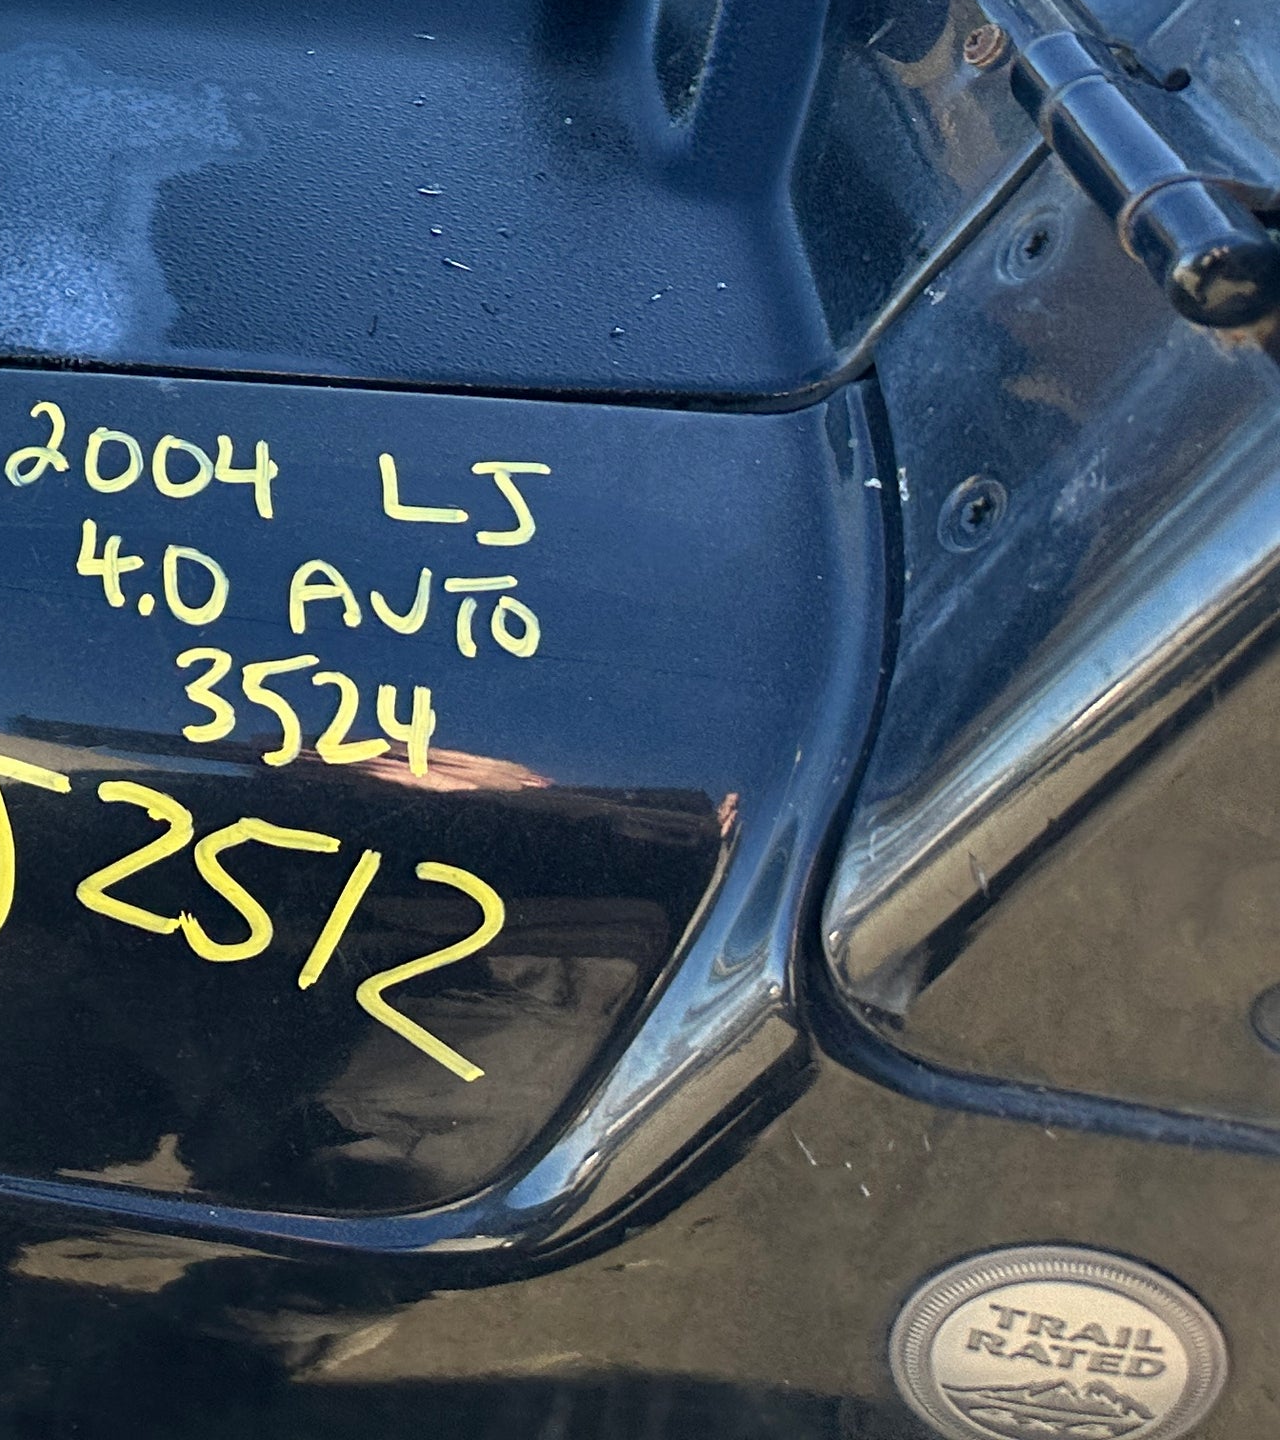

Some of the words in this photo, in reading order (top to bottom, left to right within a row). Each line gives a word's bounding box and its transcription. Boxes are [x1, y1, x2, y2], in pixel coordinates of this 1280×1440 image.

[4, 401, 279, 519] 2004
[378, 452, 552, 546] LJ
[75, 518, 230, 625] 4.0
[288, 558, 542, 658] AUTO
[176, 646, 436, 778] 3524
[966, 1328, 1167, 1378] RATED
[989, 1304, 1164, 1353] TRAIL
